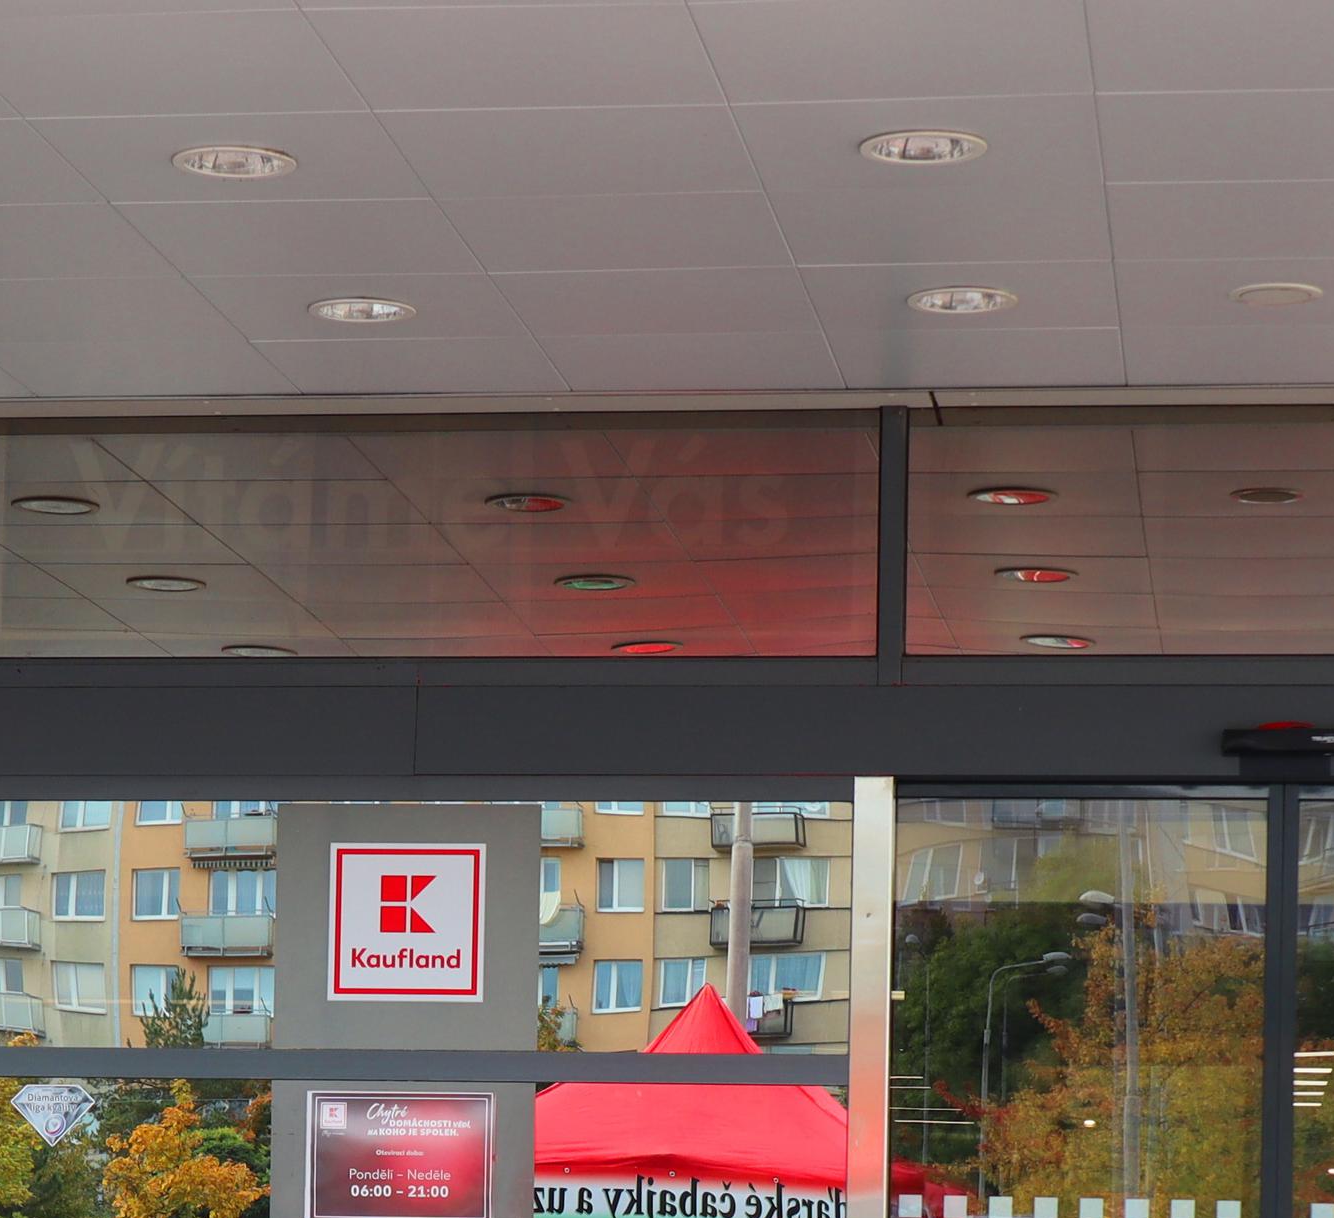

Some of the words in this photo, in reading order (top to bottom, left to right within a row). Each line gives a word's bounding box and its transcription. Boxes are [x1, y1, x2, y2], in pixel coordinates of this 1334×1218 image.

[351, 948, 461, 968] Kaufland
[366, 1103, 408, 1125] Chytré
[348, 1168, 393, 1180] Pondělí
[407, 1169, 451, 1181] Neděle
[351, 1185, 392, 1197] 06:00
[407, 1186, 449, 1198] 21:00
